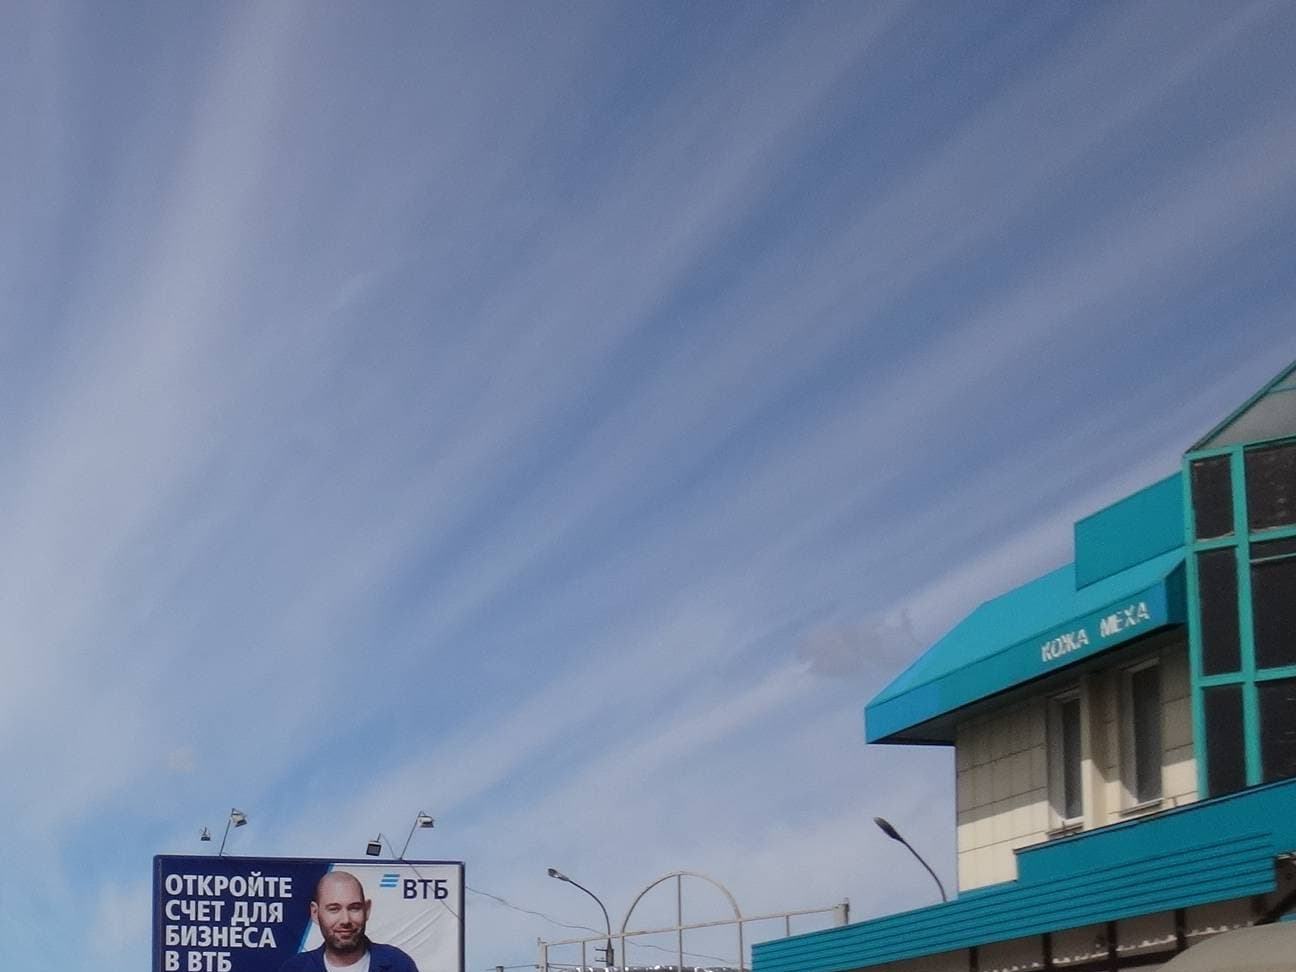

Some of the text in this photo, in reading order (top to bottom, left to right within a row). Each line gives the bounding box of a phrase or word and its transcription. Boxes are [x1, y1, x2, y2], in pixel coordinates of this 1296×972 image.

[1041, 602, 1151, 662] КОЖА МЕХА
[165, 871, 293, 898] ОТКРОЙТЕ
[403, 878, 449, 900] ВТБ
[165, 900, 283, 926] СЧЕТ ДЛЯ
[165, 925, 277, 948] БИЗНЕСА
[165, 951, 232, 972] В ВТБ
